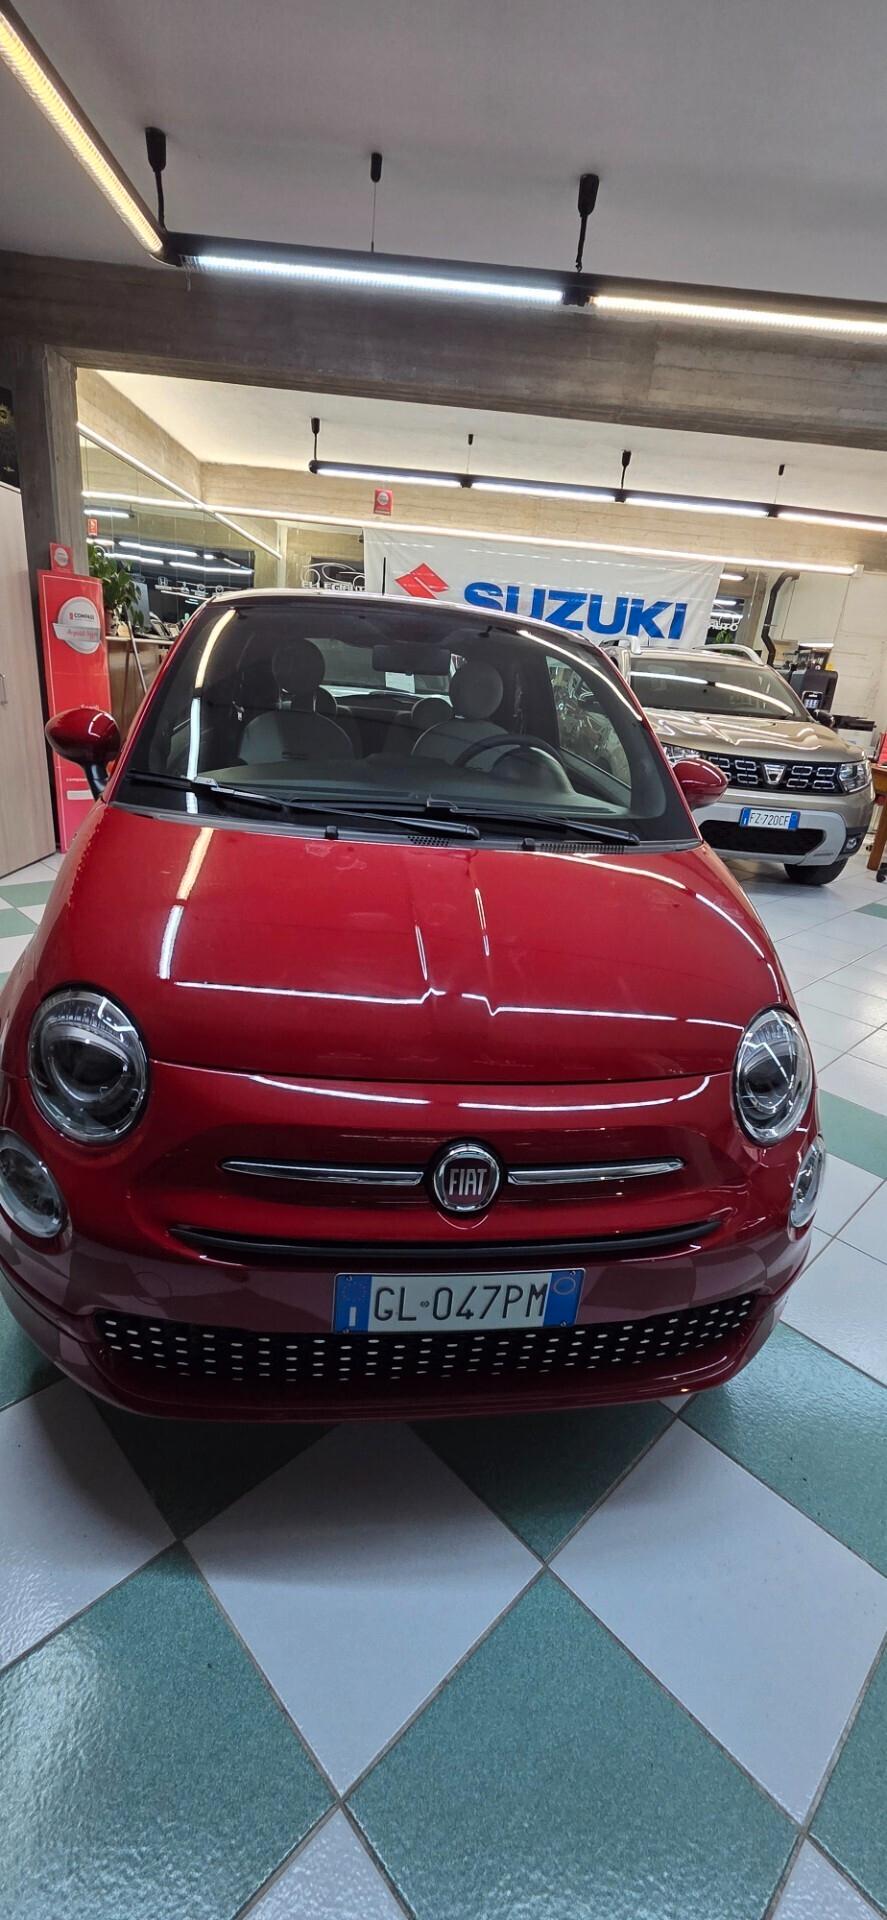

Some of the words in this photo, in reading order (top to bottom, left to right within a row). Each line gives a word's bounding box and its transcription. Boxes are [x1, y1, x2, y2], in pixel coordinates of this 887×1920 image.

[463, 581, 688, 640] SUZUKI
[448, 1167, 488, 1196] FIAT
[373, 1286, 417, 1322] GL
[432, 1283, 549, 1321] 047PM
